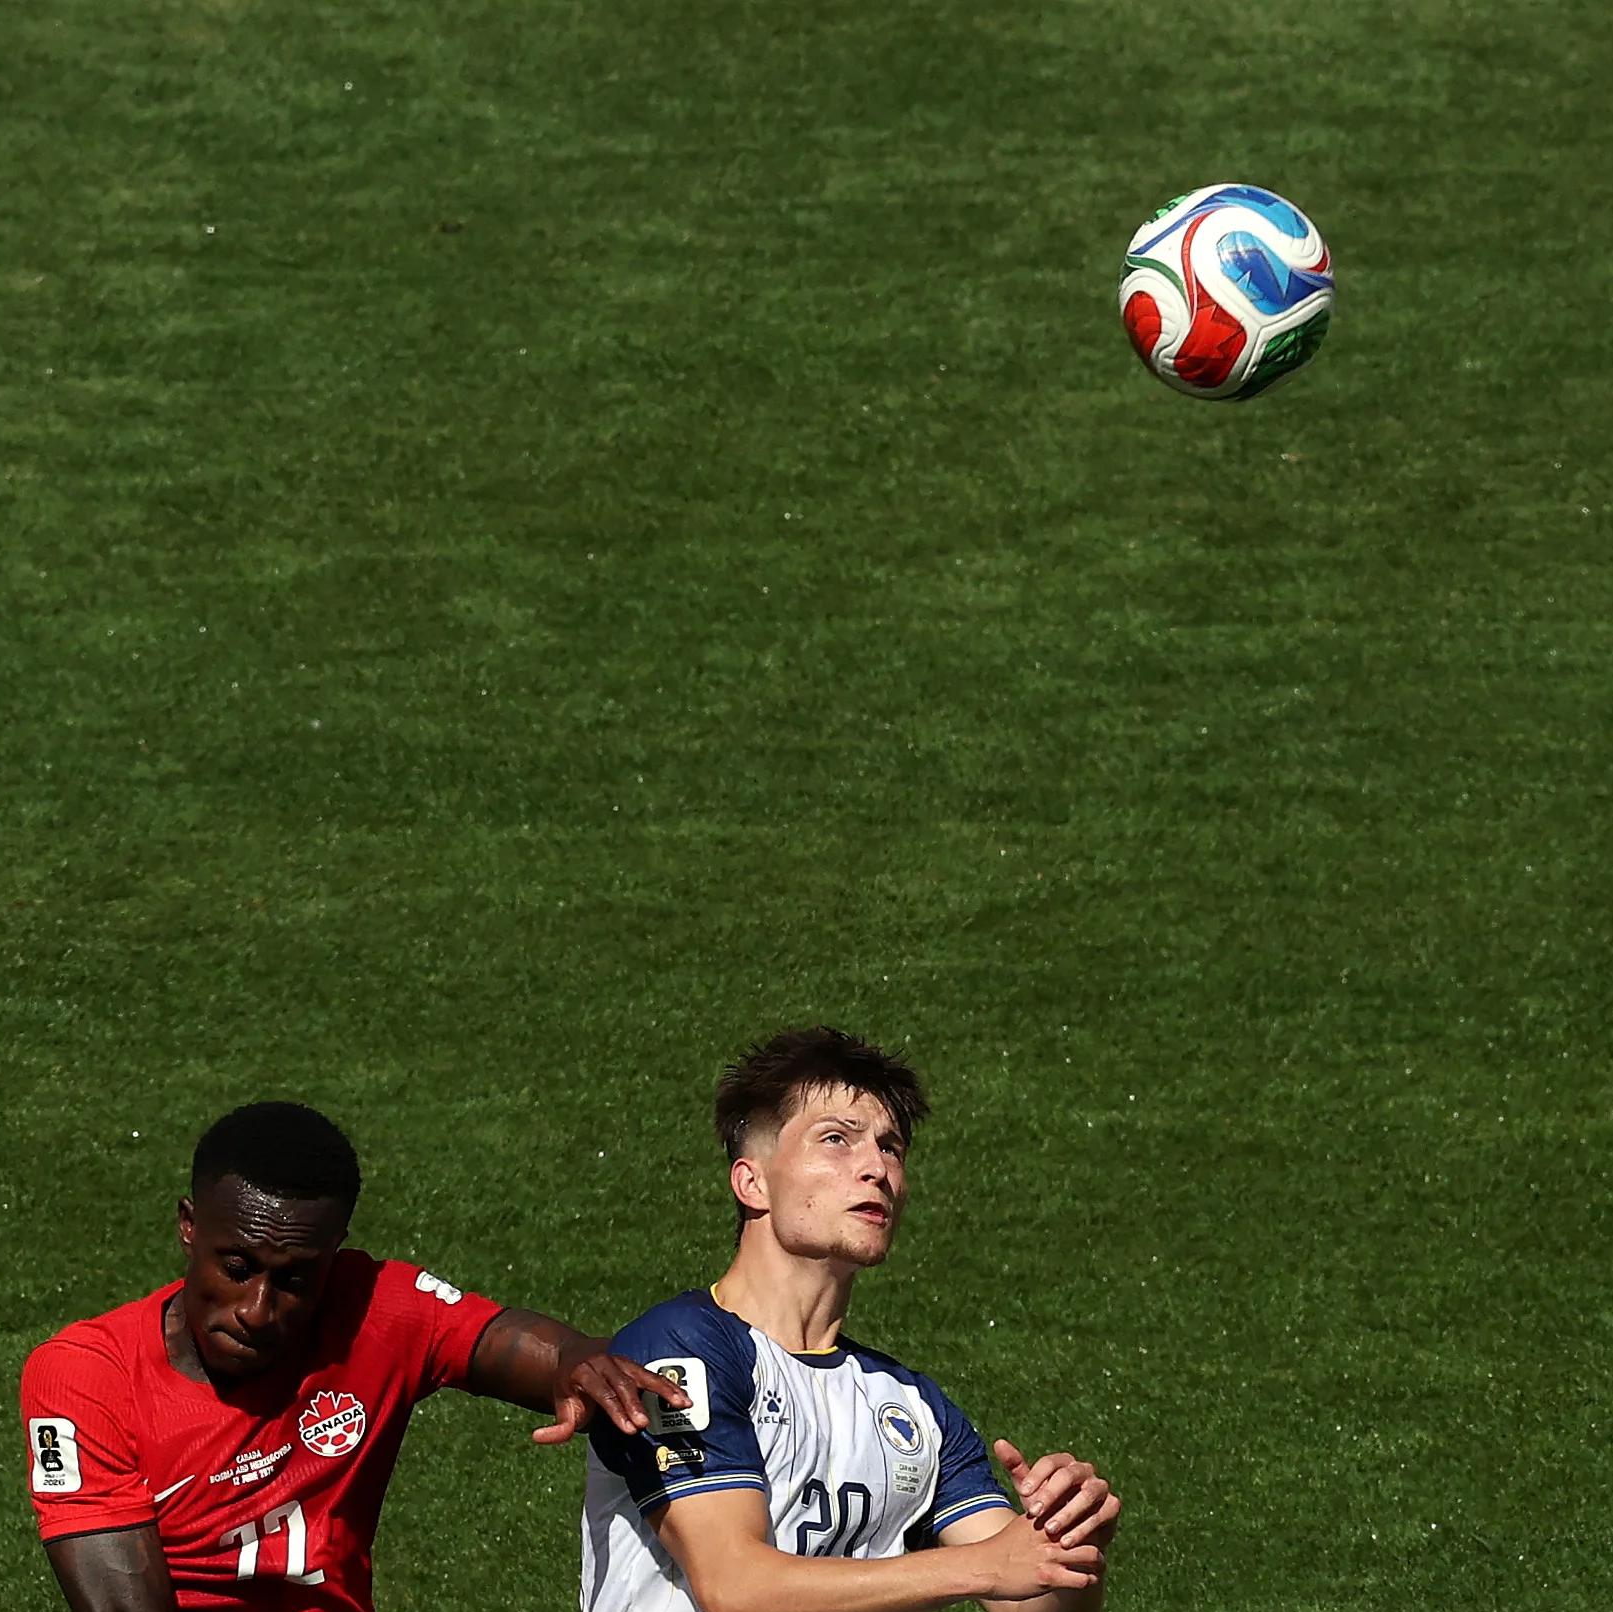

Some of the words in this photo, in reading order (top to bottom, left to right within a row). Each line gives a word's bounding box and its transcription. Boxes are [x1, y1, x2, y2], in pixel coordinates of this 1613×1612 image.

[302, 1408, 363, 1441] CANADA
[662, 1418, 692, 1428] 2026
[209, 1469, 234, 1484] BOSNIA
[235, 1464, 249, 1475] AND
[249, 1443, 292, 1471] HERZEGOVINA
[235, 1449, 263, 1464] CANADA
[232, 1476, 241, 1486] 12
[241, 1471, 259, 1484] JUNE
[796, 1477, 872, 1557] 20
